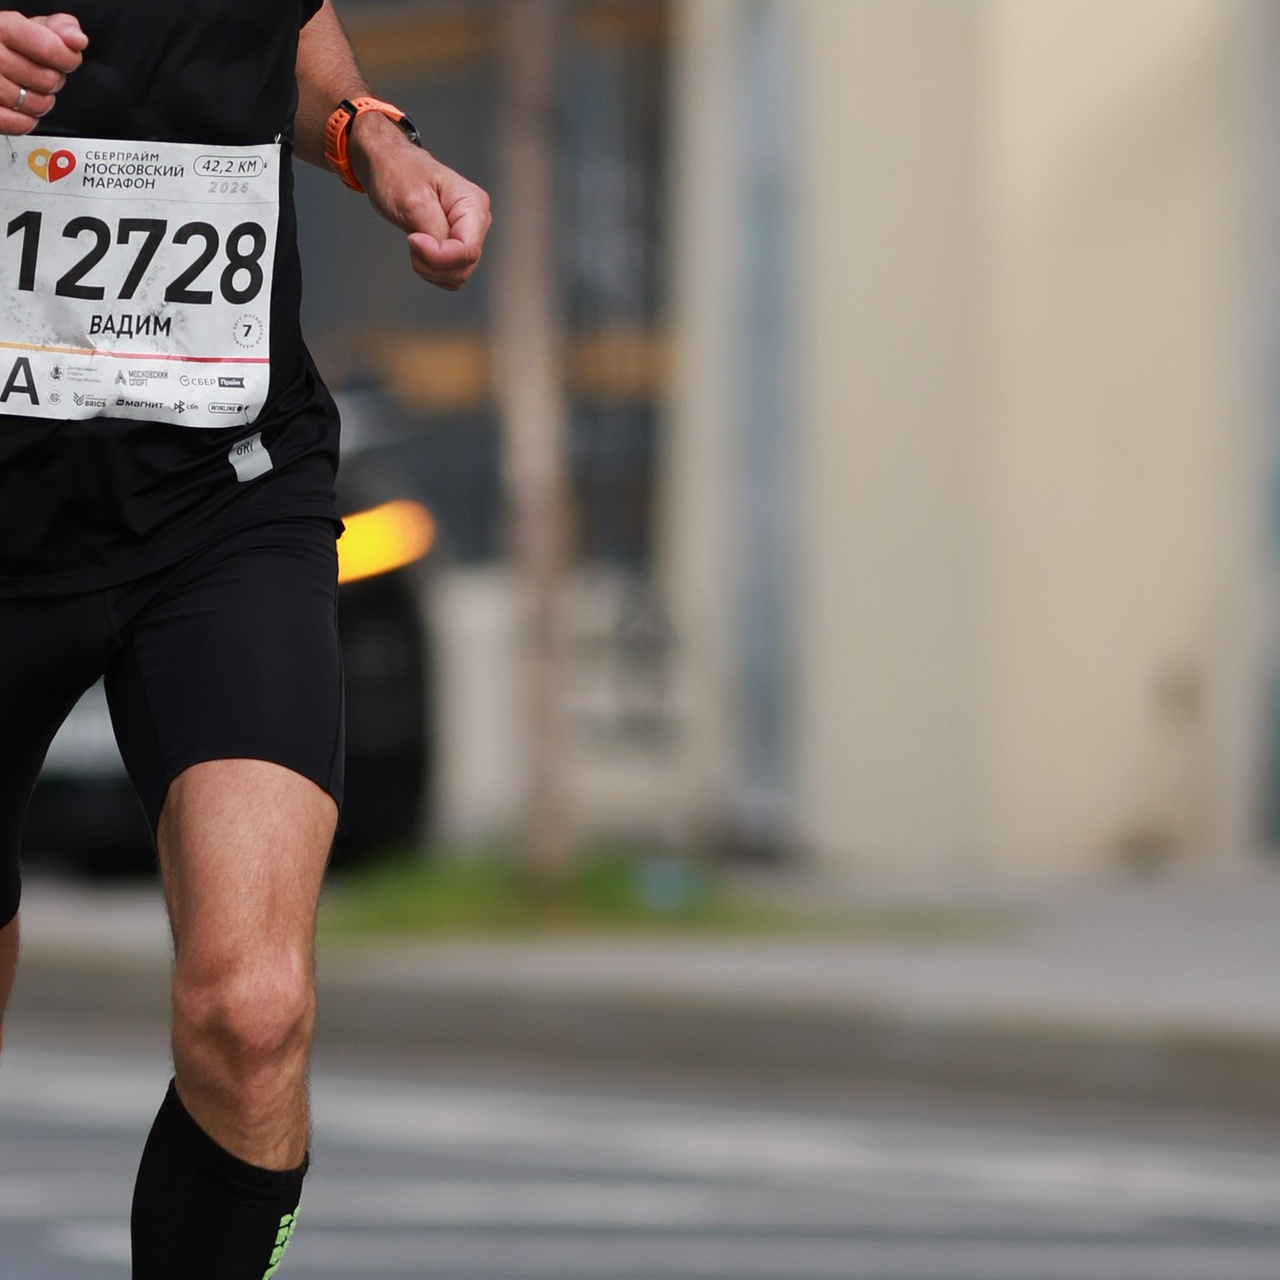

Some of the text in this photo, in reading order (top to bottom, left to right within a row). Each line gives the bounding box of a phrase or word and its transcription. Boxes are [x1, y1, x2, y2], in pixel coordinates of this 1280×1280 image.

[85, 150, 159, 163] СБЕРПРАЙМ
[83, 162, 185, 178] МОСКОВСКИЙ
[201, 160, 235, 175] 42,2
[82, 176, 156, 189] МАРАФОН
[208, 181, 249, 194] 2026
[6, 210, 267, 305] 12728
[89, 314, 172, 339] ВАДИМ
[243, 324, 253, 338] 7
[128, 369, 169, 380] МОСКОВСКИЙ
[129, 378, 149, 387] СПОРТ
[191, 378, 216, 386] СБЕР
[84, 400, 107, 408] BRICS
[124, 400, 164, 409] магнит
